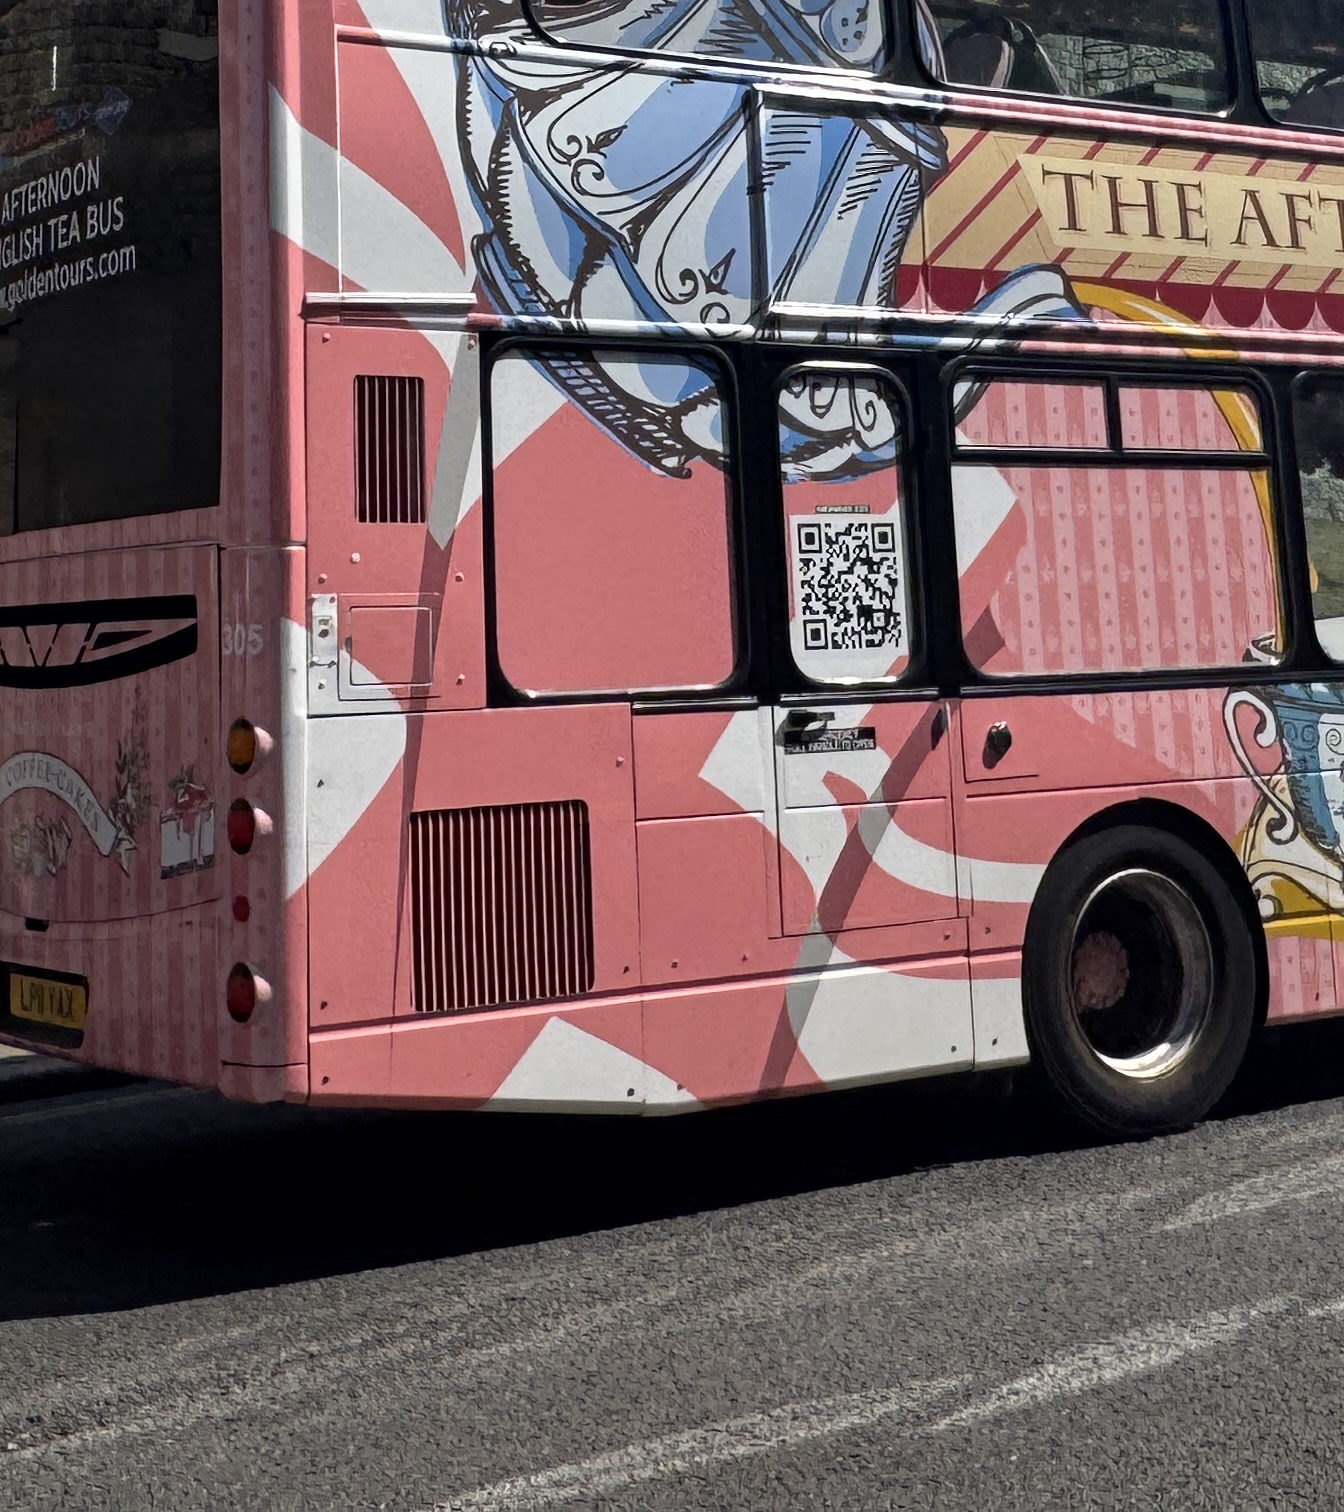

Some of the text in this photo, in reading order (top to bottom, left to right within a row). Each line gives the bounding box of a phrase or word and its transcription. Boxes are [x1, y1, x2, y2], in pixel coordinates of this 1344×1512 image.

[1, 156, 100, 222] AFTERNOON
[1040, 163, 1209, 247] THE
[47, 214, 81, 251] TEA
[86, 196, 125, 240] BUS
